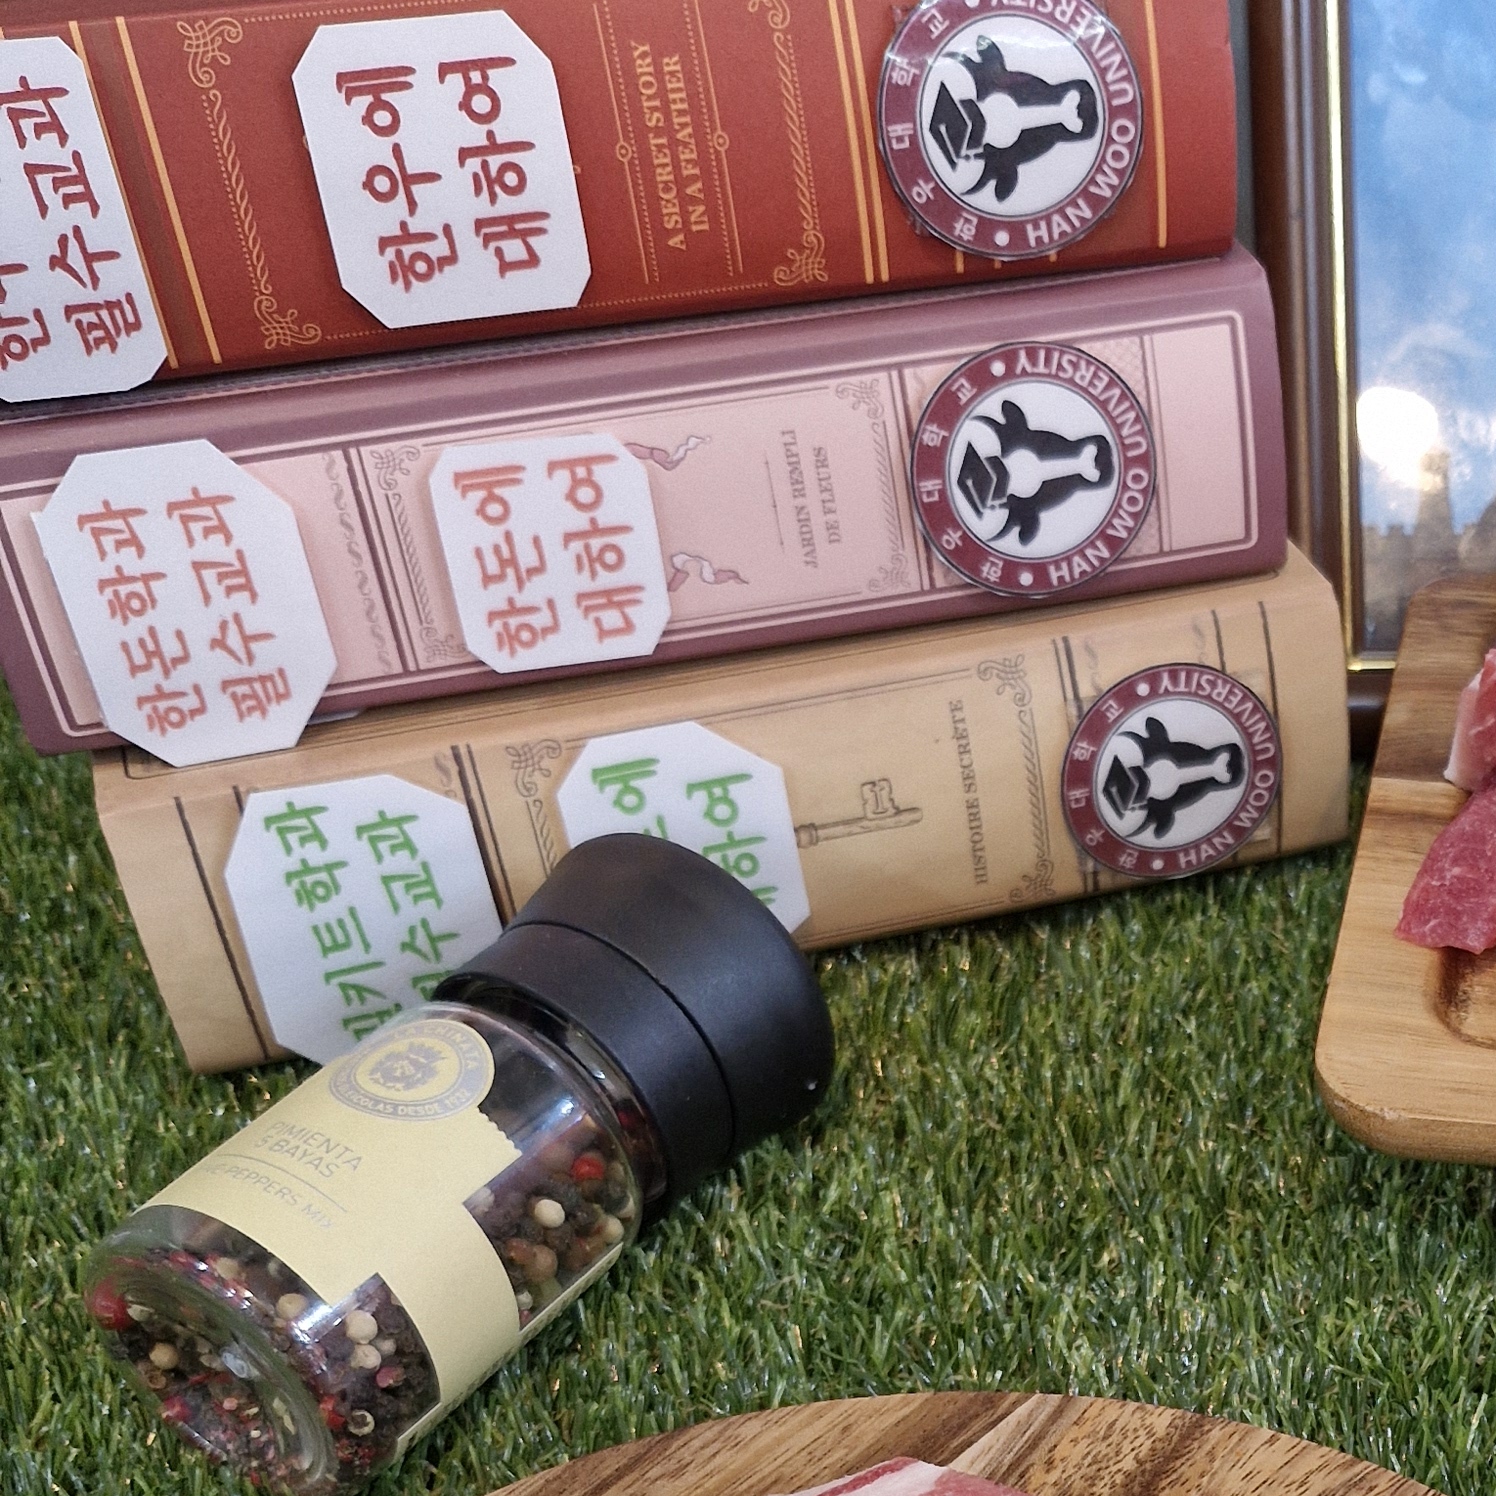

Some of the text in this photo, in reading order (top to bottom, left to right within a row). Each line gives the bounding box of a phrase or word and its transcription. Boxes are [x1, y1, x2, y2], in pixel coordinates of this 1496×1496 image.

[336, 65, 459, 293] 한우에
[438, 56, 552, 278] 대하여
[630, 39, 687, 251] A SECRET STORY
[662, 53, 710, 233] IN A FEATHER
[1025, 197, 1093, 248] HAN
[1088, 118, 1136, 198] WOO
[453, 465, 561, 659] 한돈에
[547, 454, 646, 643] 대하여
[781, 429, 819, 569] JARDIN REMPLI
[813, 446, 842, 545] DE FLEURS
[1015, 349, 1149, 586] HAN WOO UNIVERSITY
[77, 499, 208, 738] 한돈학과
[166, 486, 293, 723] 필수교과
[965, 798, 988, 886] HISTOIRE
[1158, 671, 1276, 869] HAN WOO UNIVERSITY
[224, 1165, 302, 1206] PEPPERS
[301, 1203, 332, 1228] MIX
[255, 1135, 340, 1178] 5 BAYAS
[267, 1121, 363, 1171] PIMIENTA
